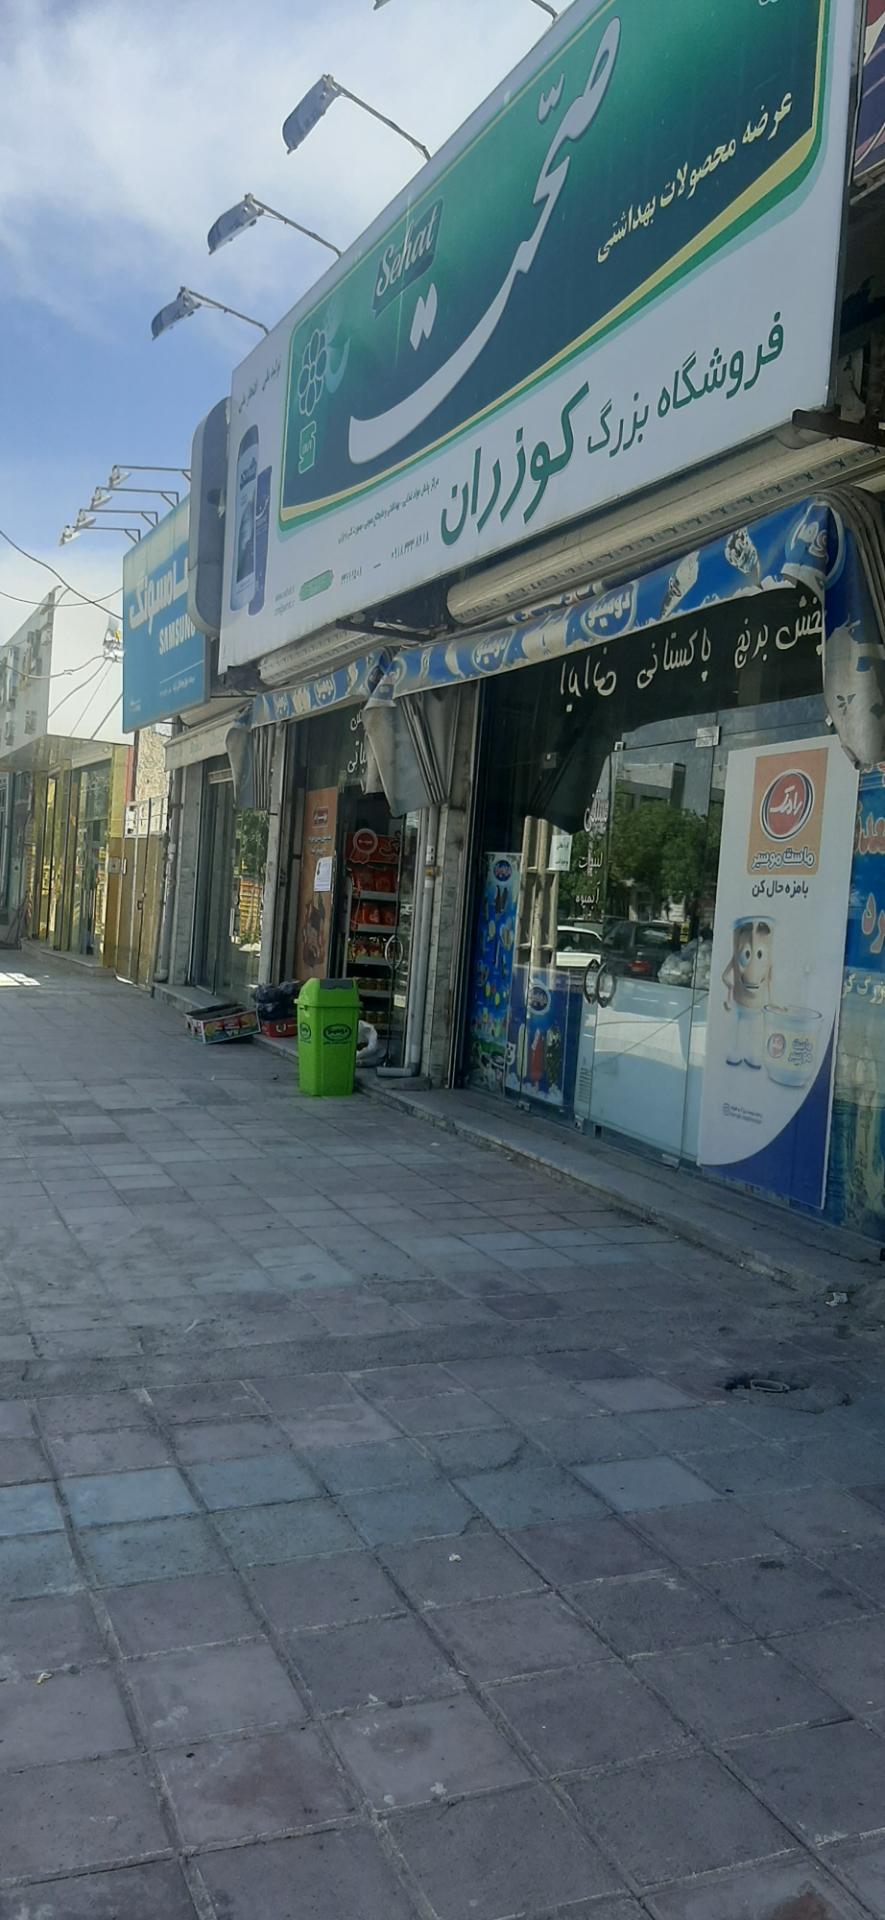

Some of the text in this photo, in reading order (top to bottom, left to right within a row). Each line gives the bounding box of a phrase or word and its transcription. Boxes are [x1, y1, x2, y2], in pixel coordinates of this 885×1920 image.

[597, 92, 791, 263] عرضه محصولات بهداشتی
[376, 204, 439, 297] Sehat
[657, 311, 784, 418] فروشگاه
[440, 381, 590, 546] کوزران
[587, 392, 649, 458] بزرگ
[752, 847, 815, 871] ماست موسیر
[752, 880, 766, 898] کن
[767, 880, 784, 898] حال
